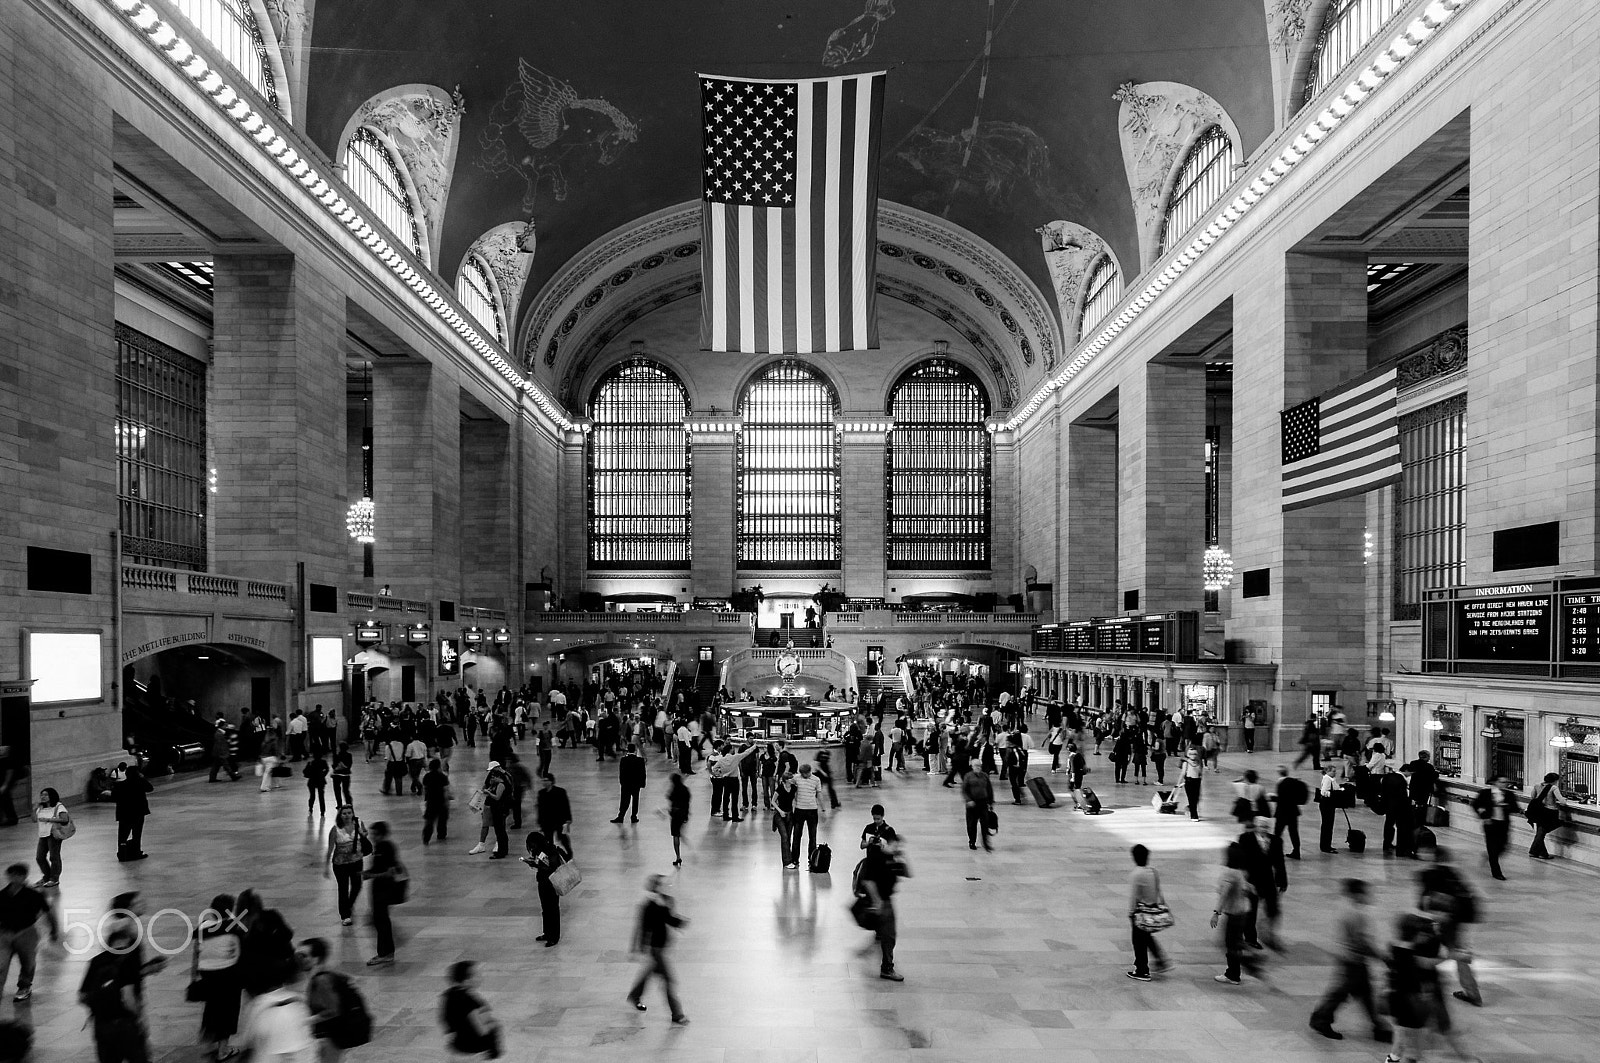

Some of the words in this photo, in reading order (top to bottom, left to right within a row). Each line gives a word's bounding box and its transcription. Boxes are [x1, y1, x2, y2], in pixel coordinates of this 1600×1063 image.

[1475, 584, 1533, 596] INFORMATION
[1566, 596, 1586, 604] TIME
[1466, 611, 1485, 619] SERVICE
[1517, 609, 1543, 617] STATIONS
[1572, 607, 1587, 615] 2:48
[1572, 617, 1586, 625] 2:51
[1572, 627, 1587, 635] 2:55
[228, 632, 243, 642] 45TH
[243, 635, 265, 648] STREET
[1571, 637, 1587, 645] 3:17
[122, 649, 138, 662] THE
[138, 637, 171, 655] METLIFE
[172, 631, 207, 645] BUILDING
[1571, 647, 1587, 655] 3:20
